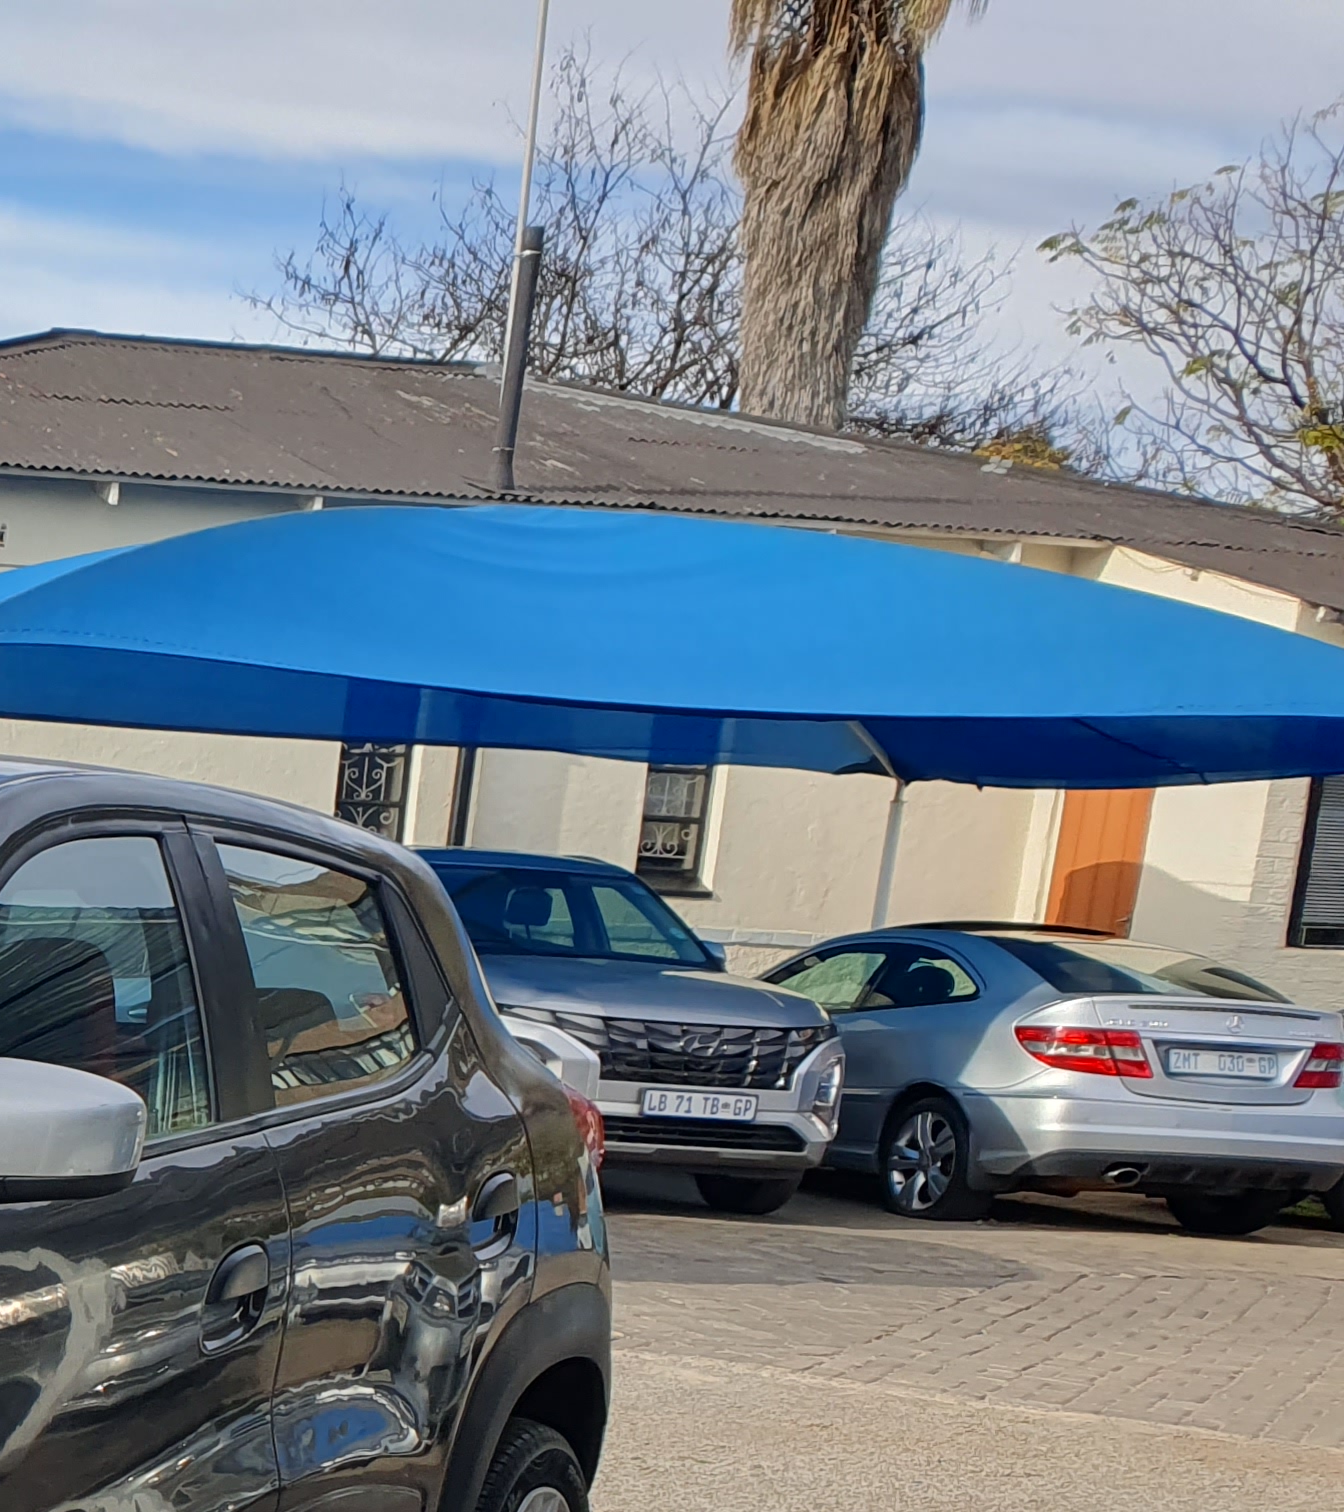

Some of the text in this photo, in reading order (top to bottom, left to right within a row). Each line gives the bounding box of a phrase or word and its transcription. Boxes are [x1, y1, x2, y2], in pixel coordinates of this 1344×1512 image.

[1258, 1056, 1275, 1074] GP
[647, 1093, 752, 1116] LB 71 TB GP
